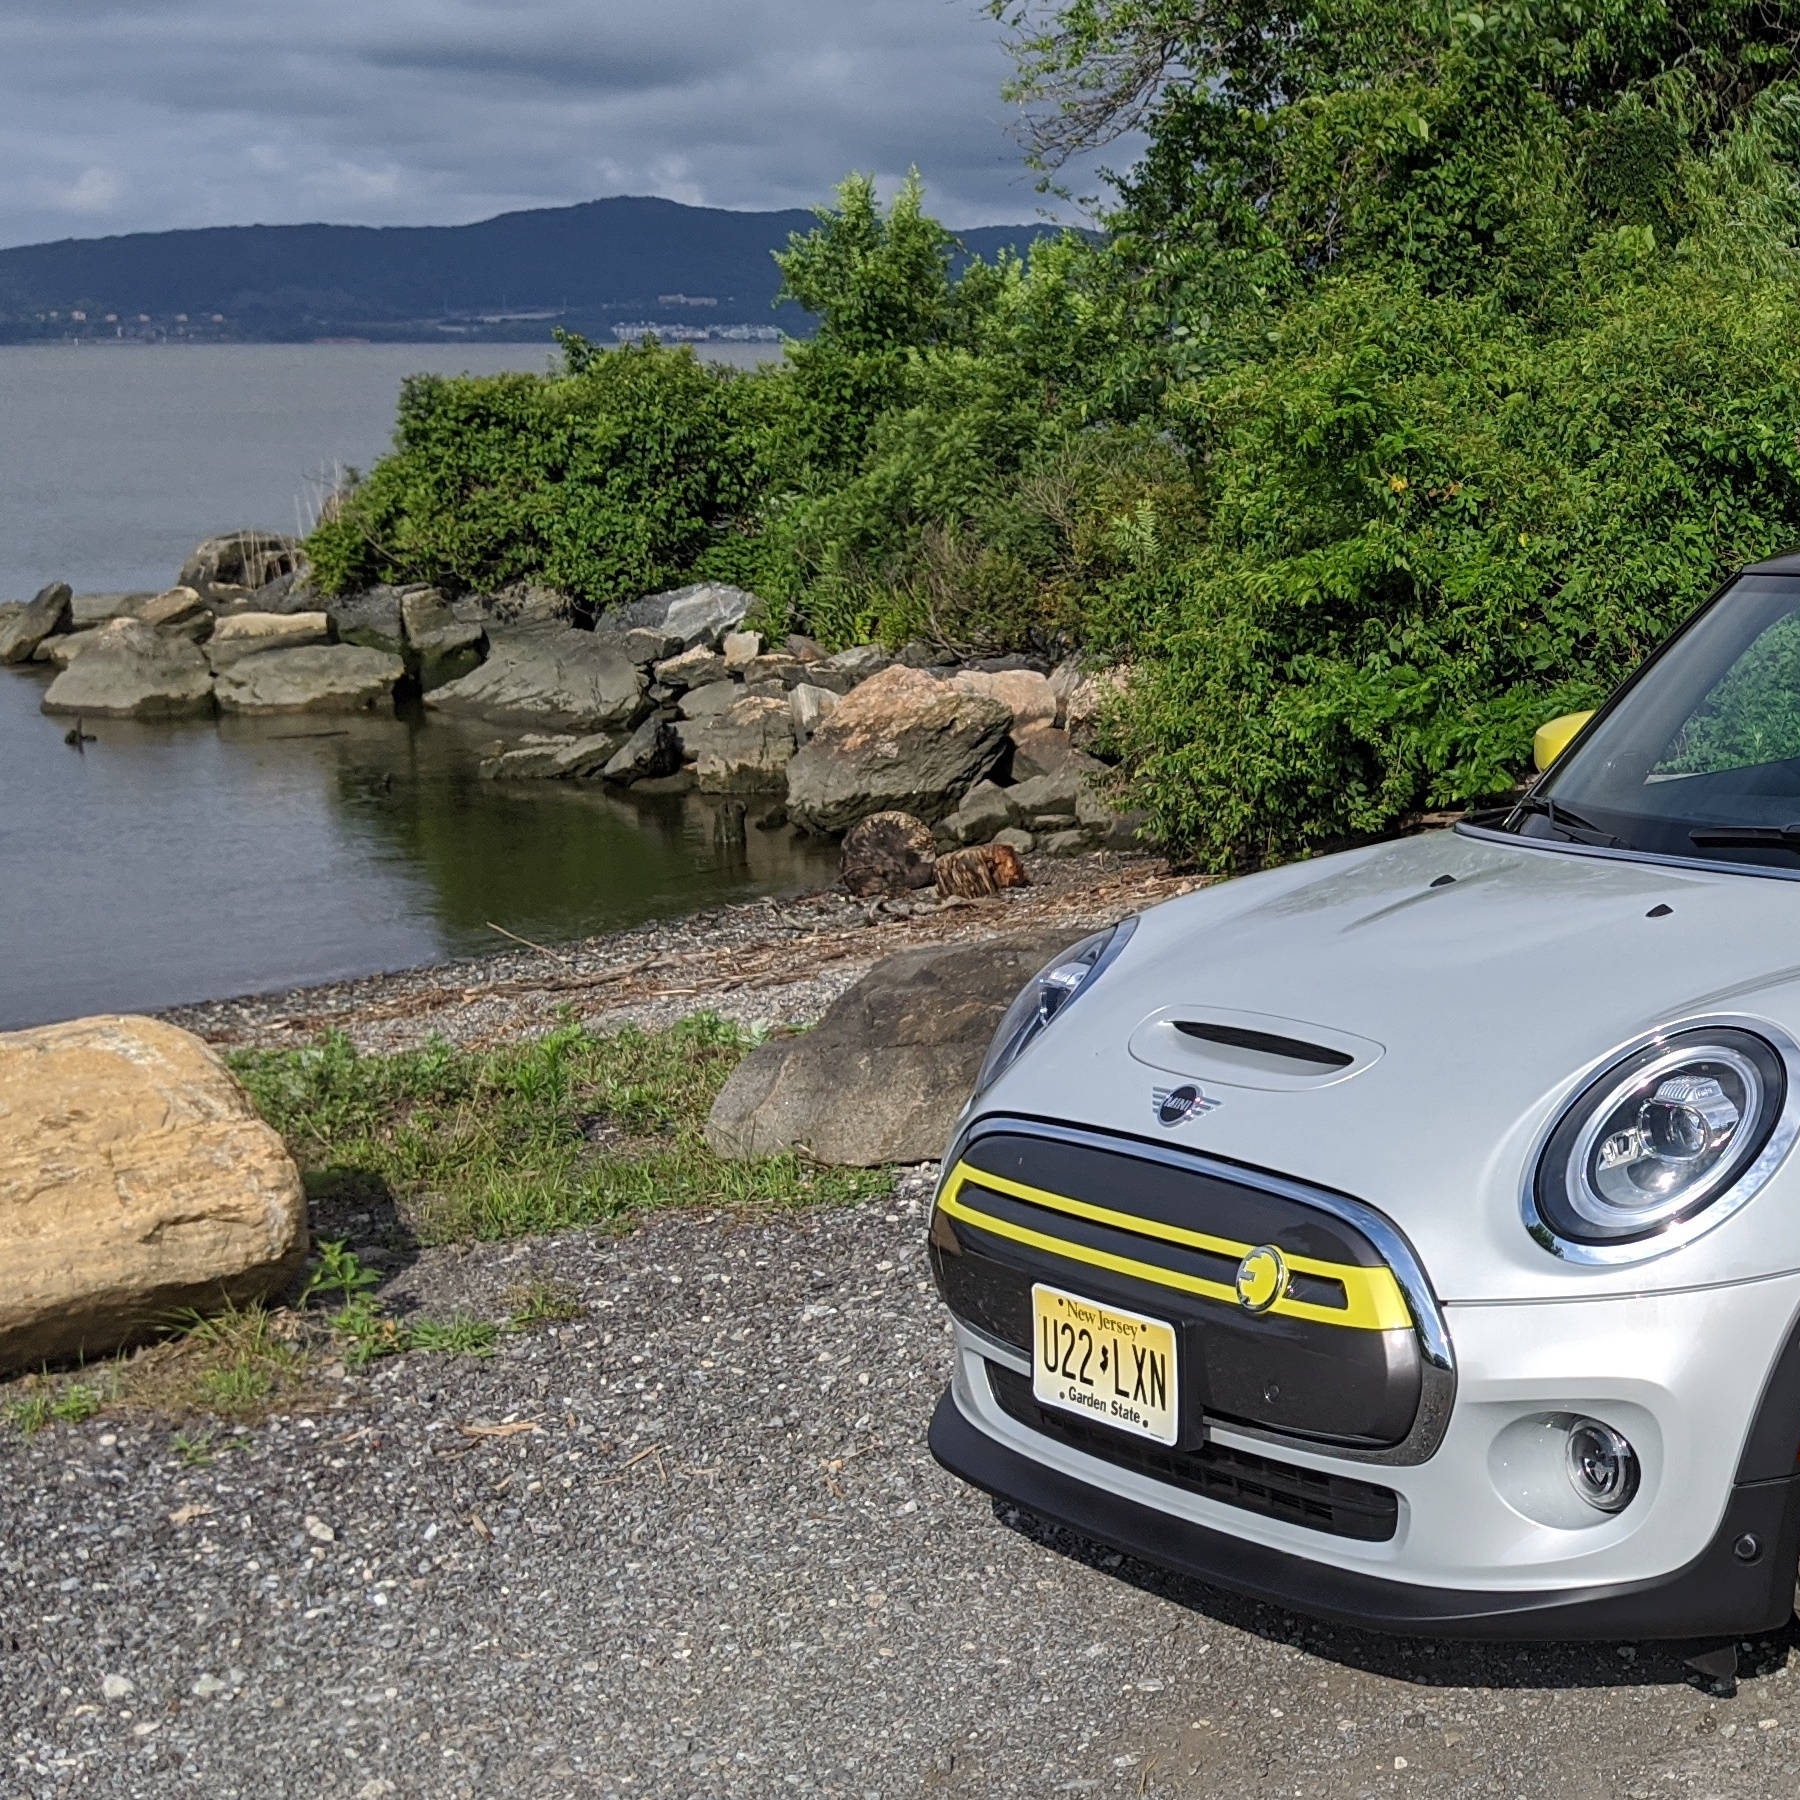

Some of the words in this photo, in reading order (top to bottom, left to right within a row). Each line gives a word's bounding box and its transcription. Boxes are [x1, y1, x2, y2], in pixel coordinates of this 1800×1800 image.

[1163, 1095, 1193, 1111] MINI
[1067, 1299, 1096, 1322] New
[1098, 1310, 1138, 1341] Jersey
[1068, 1386, 1107, 1412] Garden
[1110, 1400, 1141, 1424] State
